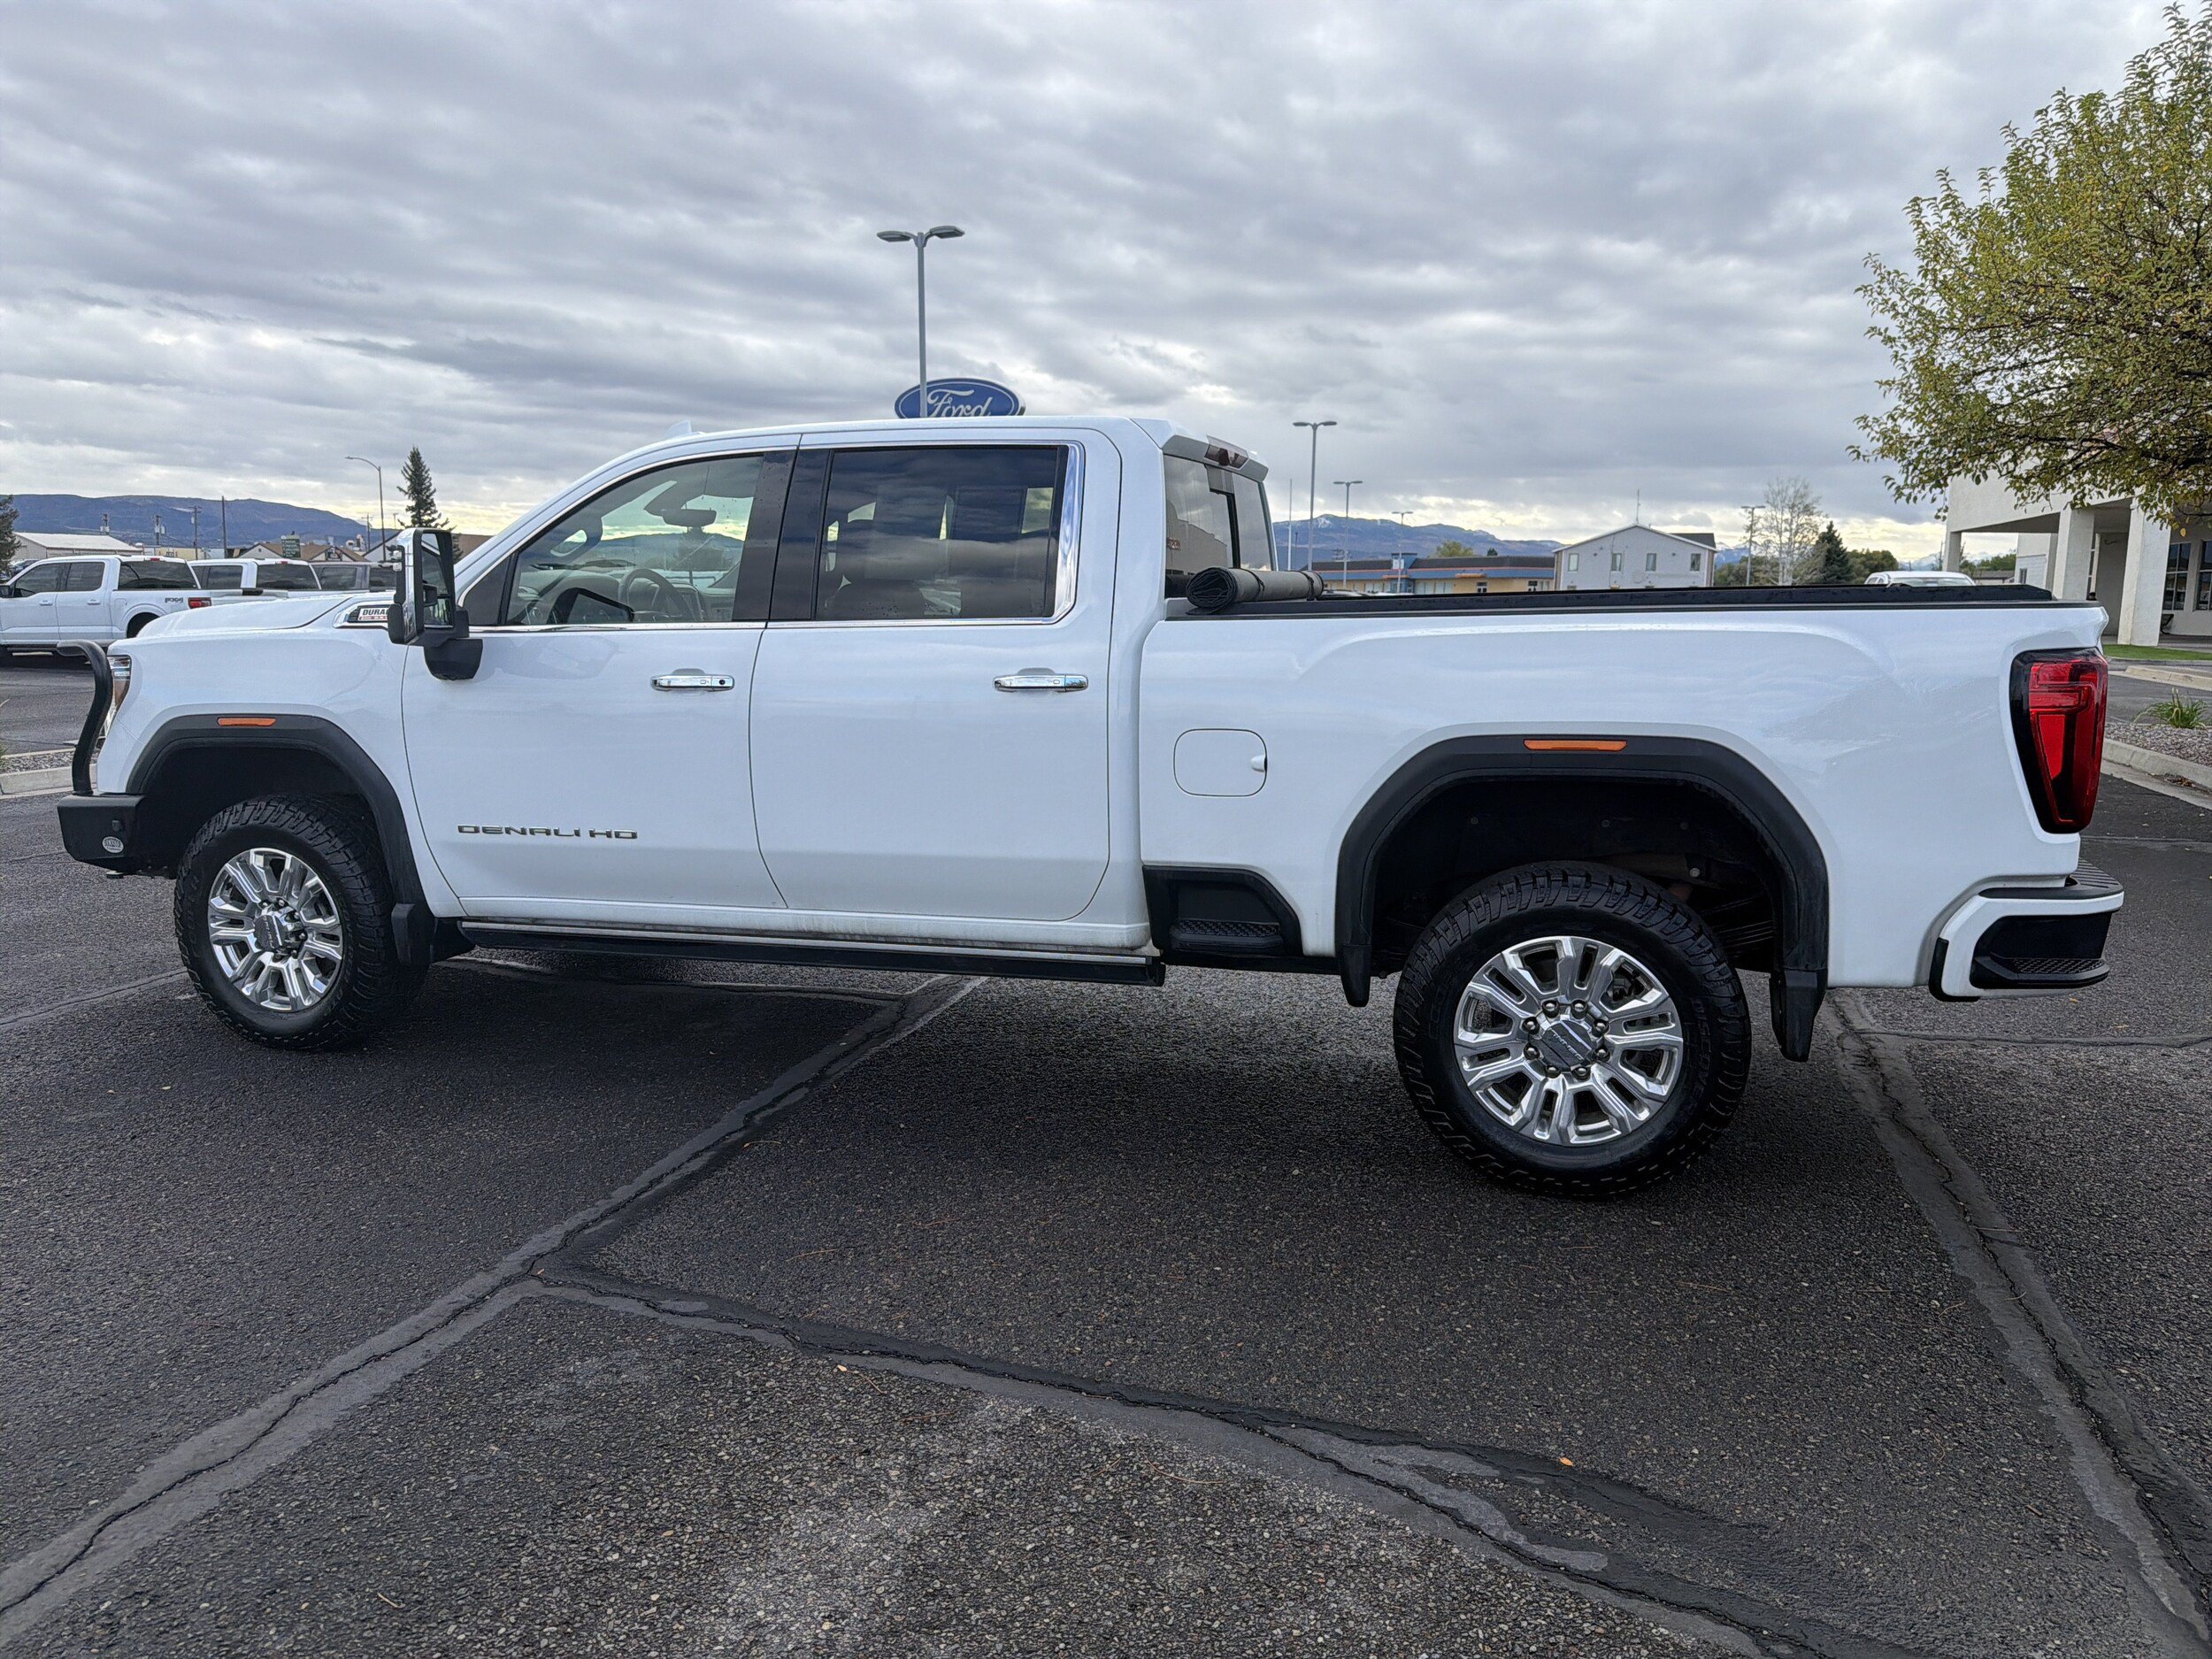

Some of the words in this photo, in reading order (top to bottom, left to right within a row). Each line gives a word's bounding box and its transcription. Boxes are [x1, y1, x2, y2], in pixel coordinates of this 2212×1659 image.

[926, 388, 994, 417] Ford
[457, 825, 581, 837] DENALI
[588, 828, 638, 840] HD
